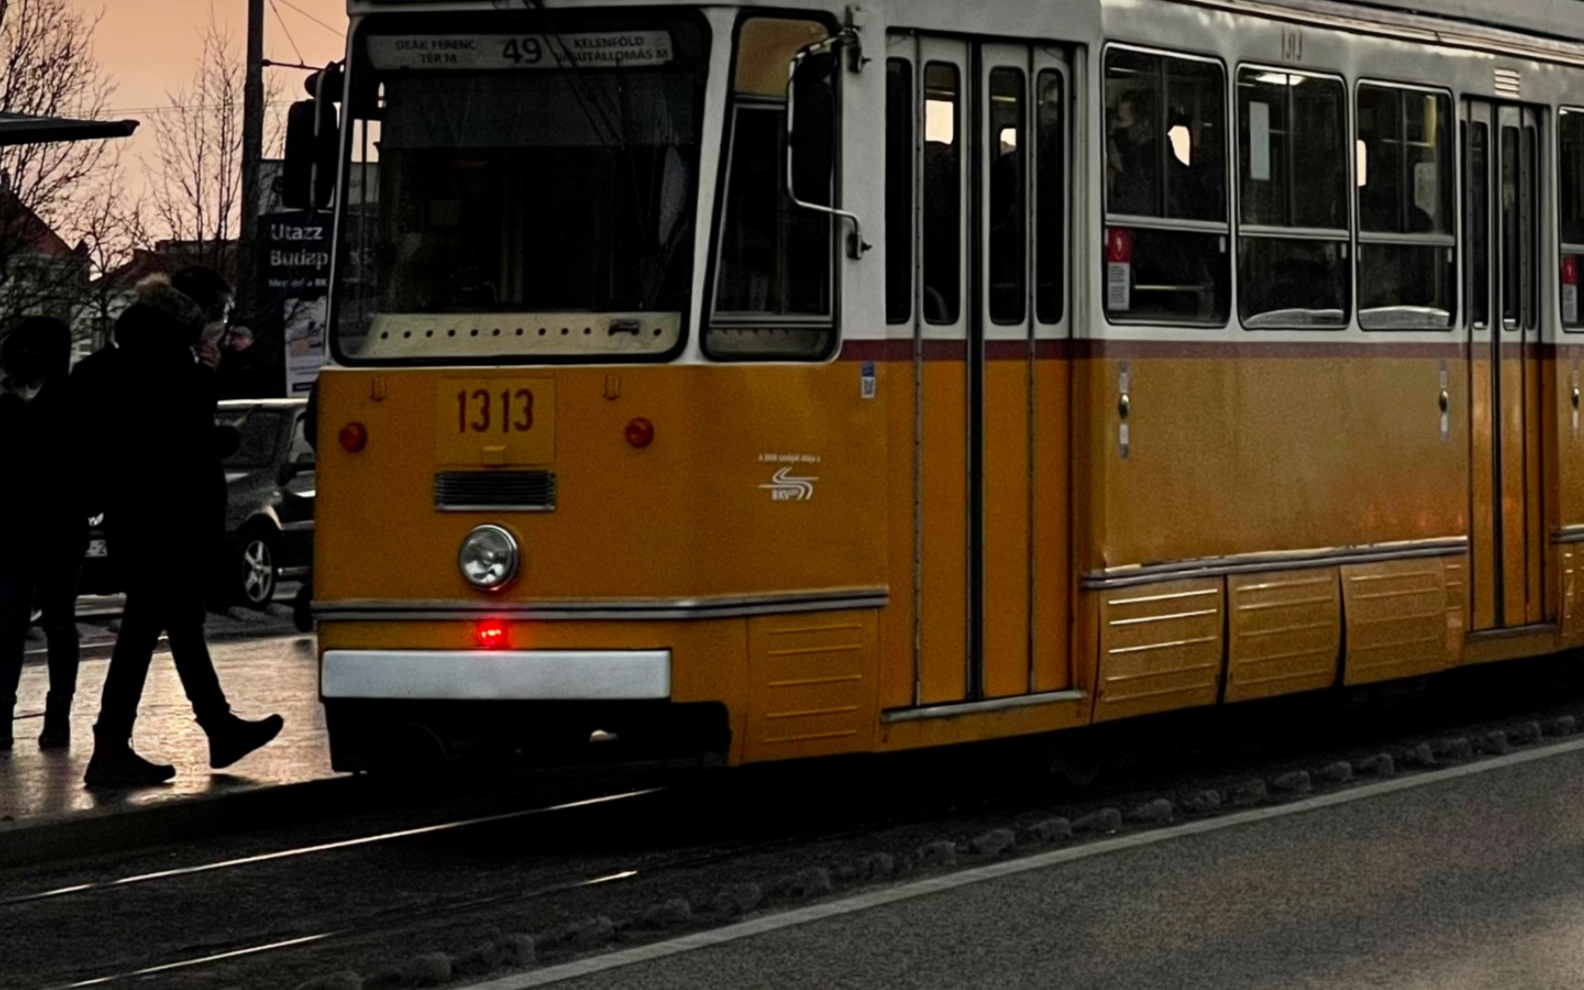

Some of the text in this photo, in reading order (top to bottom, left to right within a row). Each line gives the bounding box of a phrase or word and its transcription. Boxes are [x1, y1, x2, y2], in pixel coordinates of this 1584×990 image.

[395, 38, 477, 51] DEÁK FERENC
[573, 36, 645, 49] KELENFÖLD
[502, 37, 542, 65] 49
[656, 48, 669, 59] M
[420, 53, 457, 64] TÉR M
[270, 223, 323, 241] Utazz
[457, 388, 534, 434] 1313
